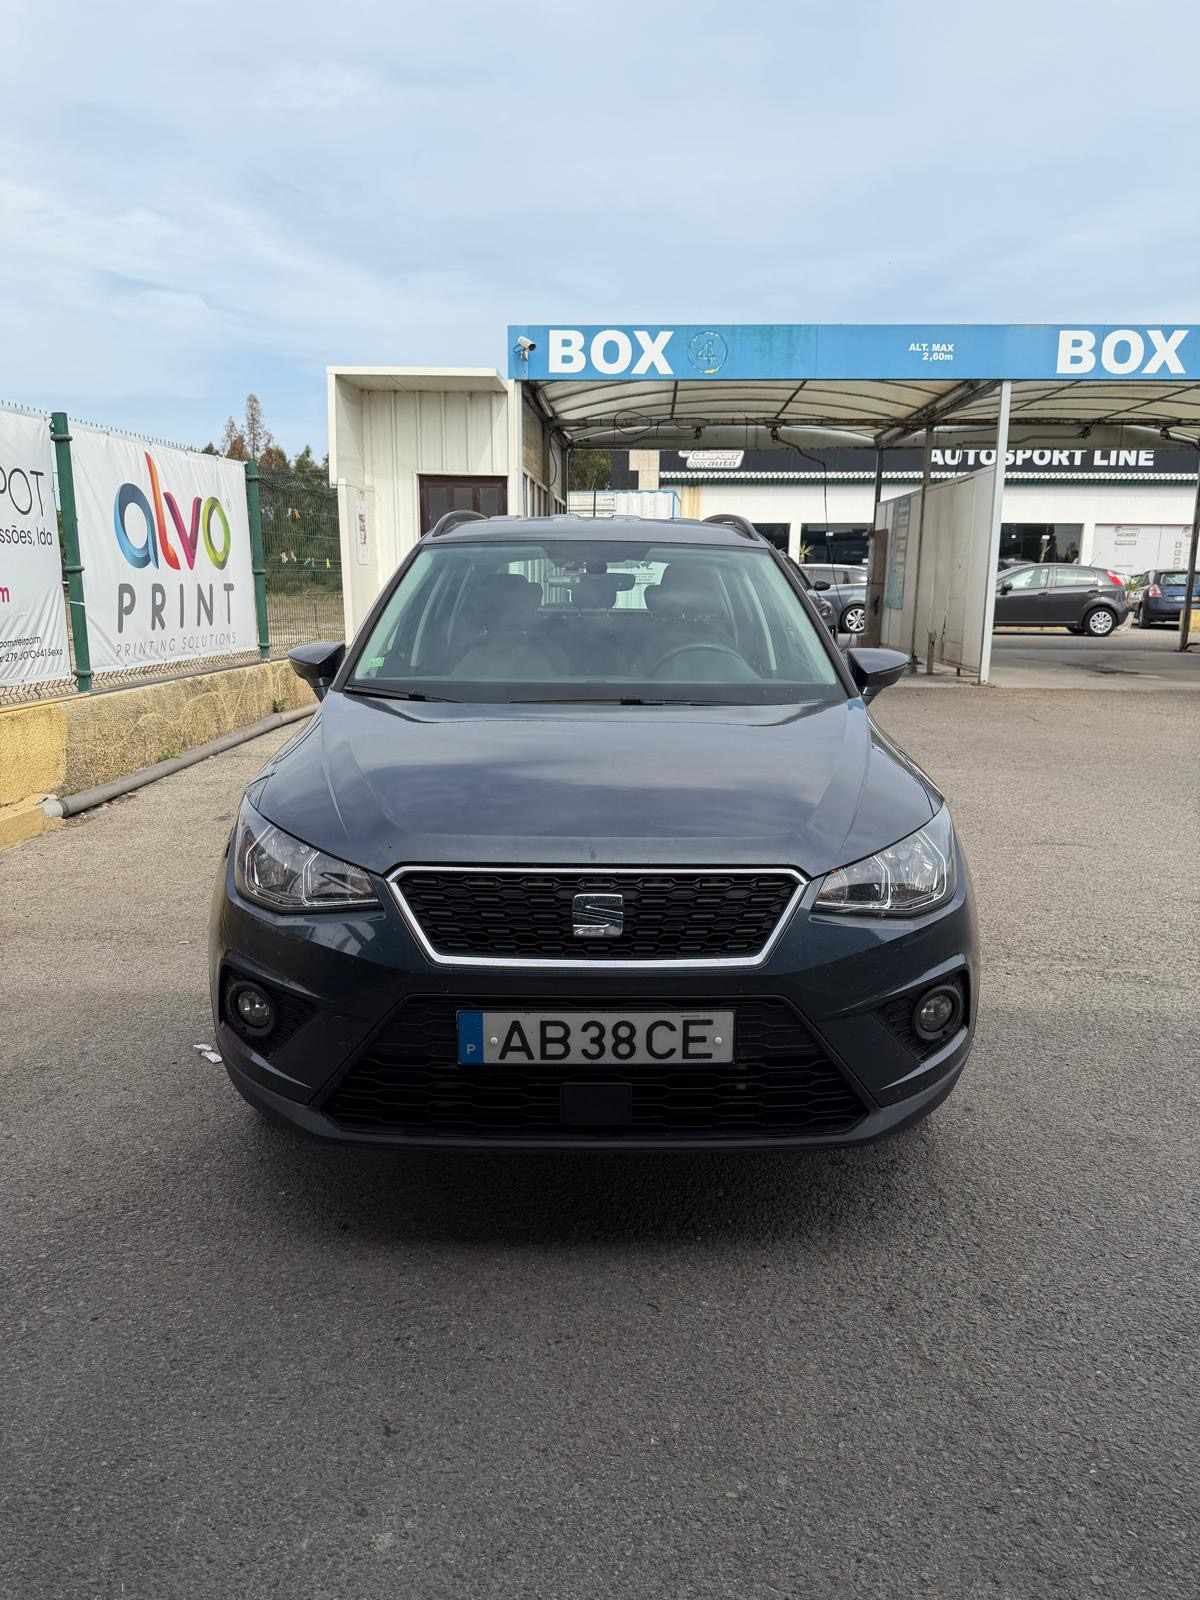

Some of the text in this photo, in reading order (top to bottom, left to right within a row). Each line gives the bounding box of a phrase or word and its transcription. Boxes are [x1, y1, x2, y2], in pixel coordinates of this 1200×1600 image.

[549, 329, 675, 375] BOX
[908, 343, 954, 352] ALT. MAX
[1056, 329, 1190, 375] BOX
[1093, 449, 1155, 467] LINE
[117, 583, 235, 634] PRINT
[114, 639, 176, 657] PRINTNG
[466, 1043, 477, 1055] P
